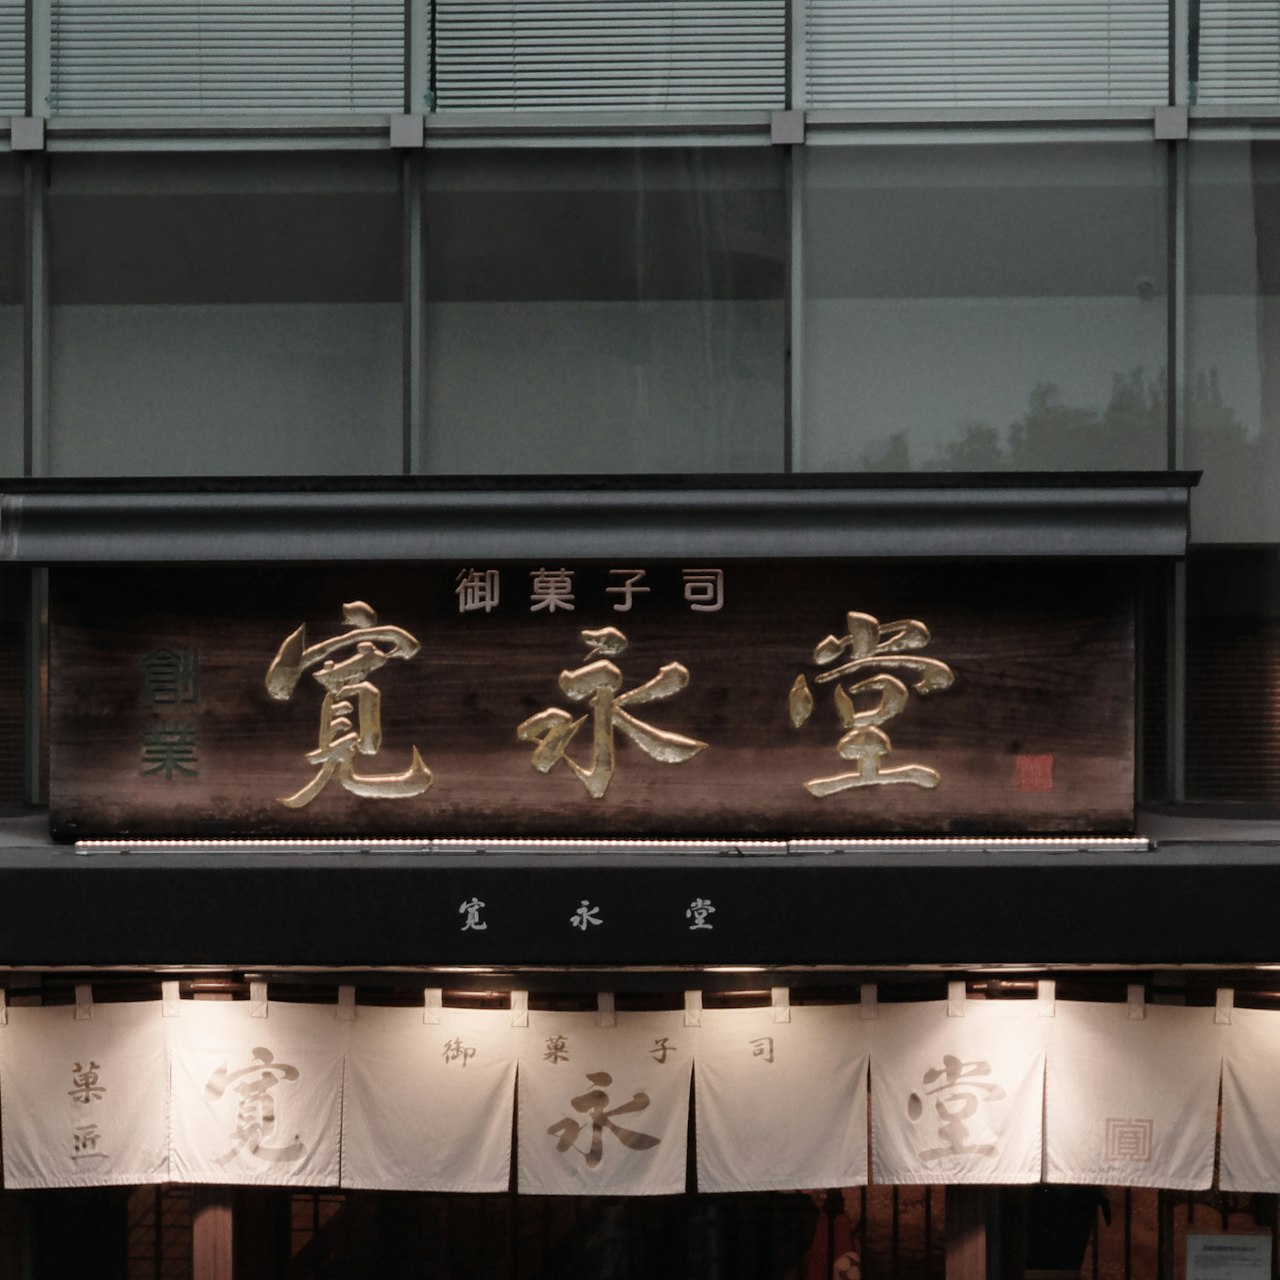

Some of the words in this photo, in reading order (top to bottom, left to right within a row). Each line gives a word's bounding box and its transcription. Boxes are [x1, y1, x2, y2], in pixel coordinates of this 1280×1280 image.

[455, 567, 728, 613] 御菓子司
[139, 647, 201, 781] 創業
[458, 897, 717, 932] 寛永堂
[67, 1060, 109, 1161] 菓匠
